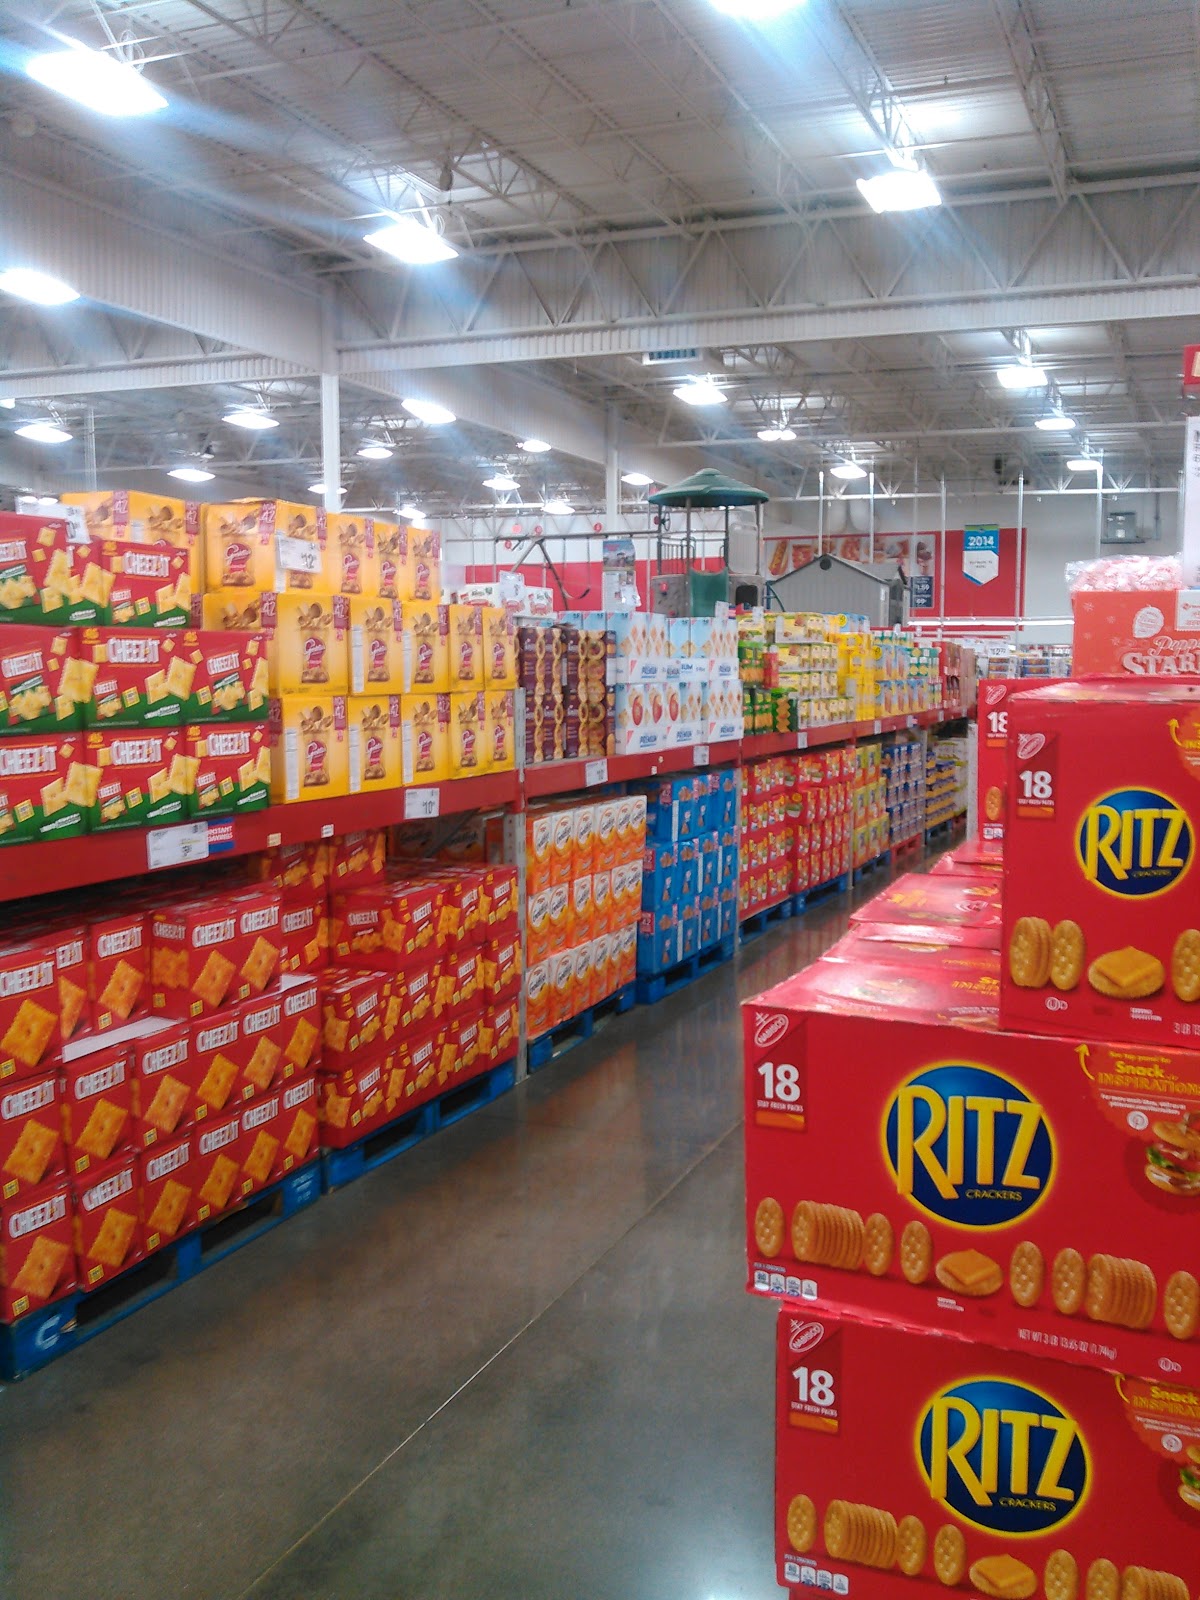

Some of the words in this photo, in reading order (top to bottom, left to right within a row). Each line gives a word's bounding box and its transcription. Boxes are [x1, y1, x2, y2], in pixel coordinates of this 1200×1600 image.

[968, 535, 994, 547] 2014
[1020, 770, 1052, 799] 18
[1085, 804, 1187, 881] RITZ
[757, 1062, 801, 1102] 18
[1115, 1061, 1164, 1079] Snack
[896, 1084, 1042, 1200] RITZ
[965, 1188, 1023, 1202] CRACKERS
[1018, 1328, 1031, 1340] NET
[1032, 1330, 1042, 1342] WT
[1044, 1333, 1049, 1345] 3
[792, 1366, 835, 1407] 18
[1151, 1385, 1199, 1405] Snack
[930, 1395, 1077, 1507] RITZ
[999, 1497, 1057, 1512] CRACKERS
